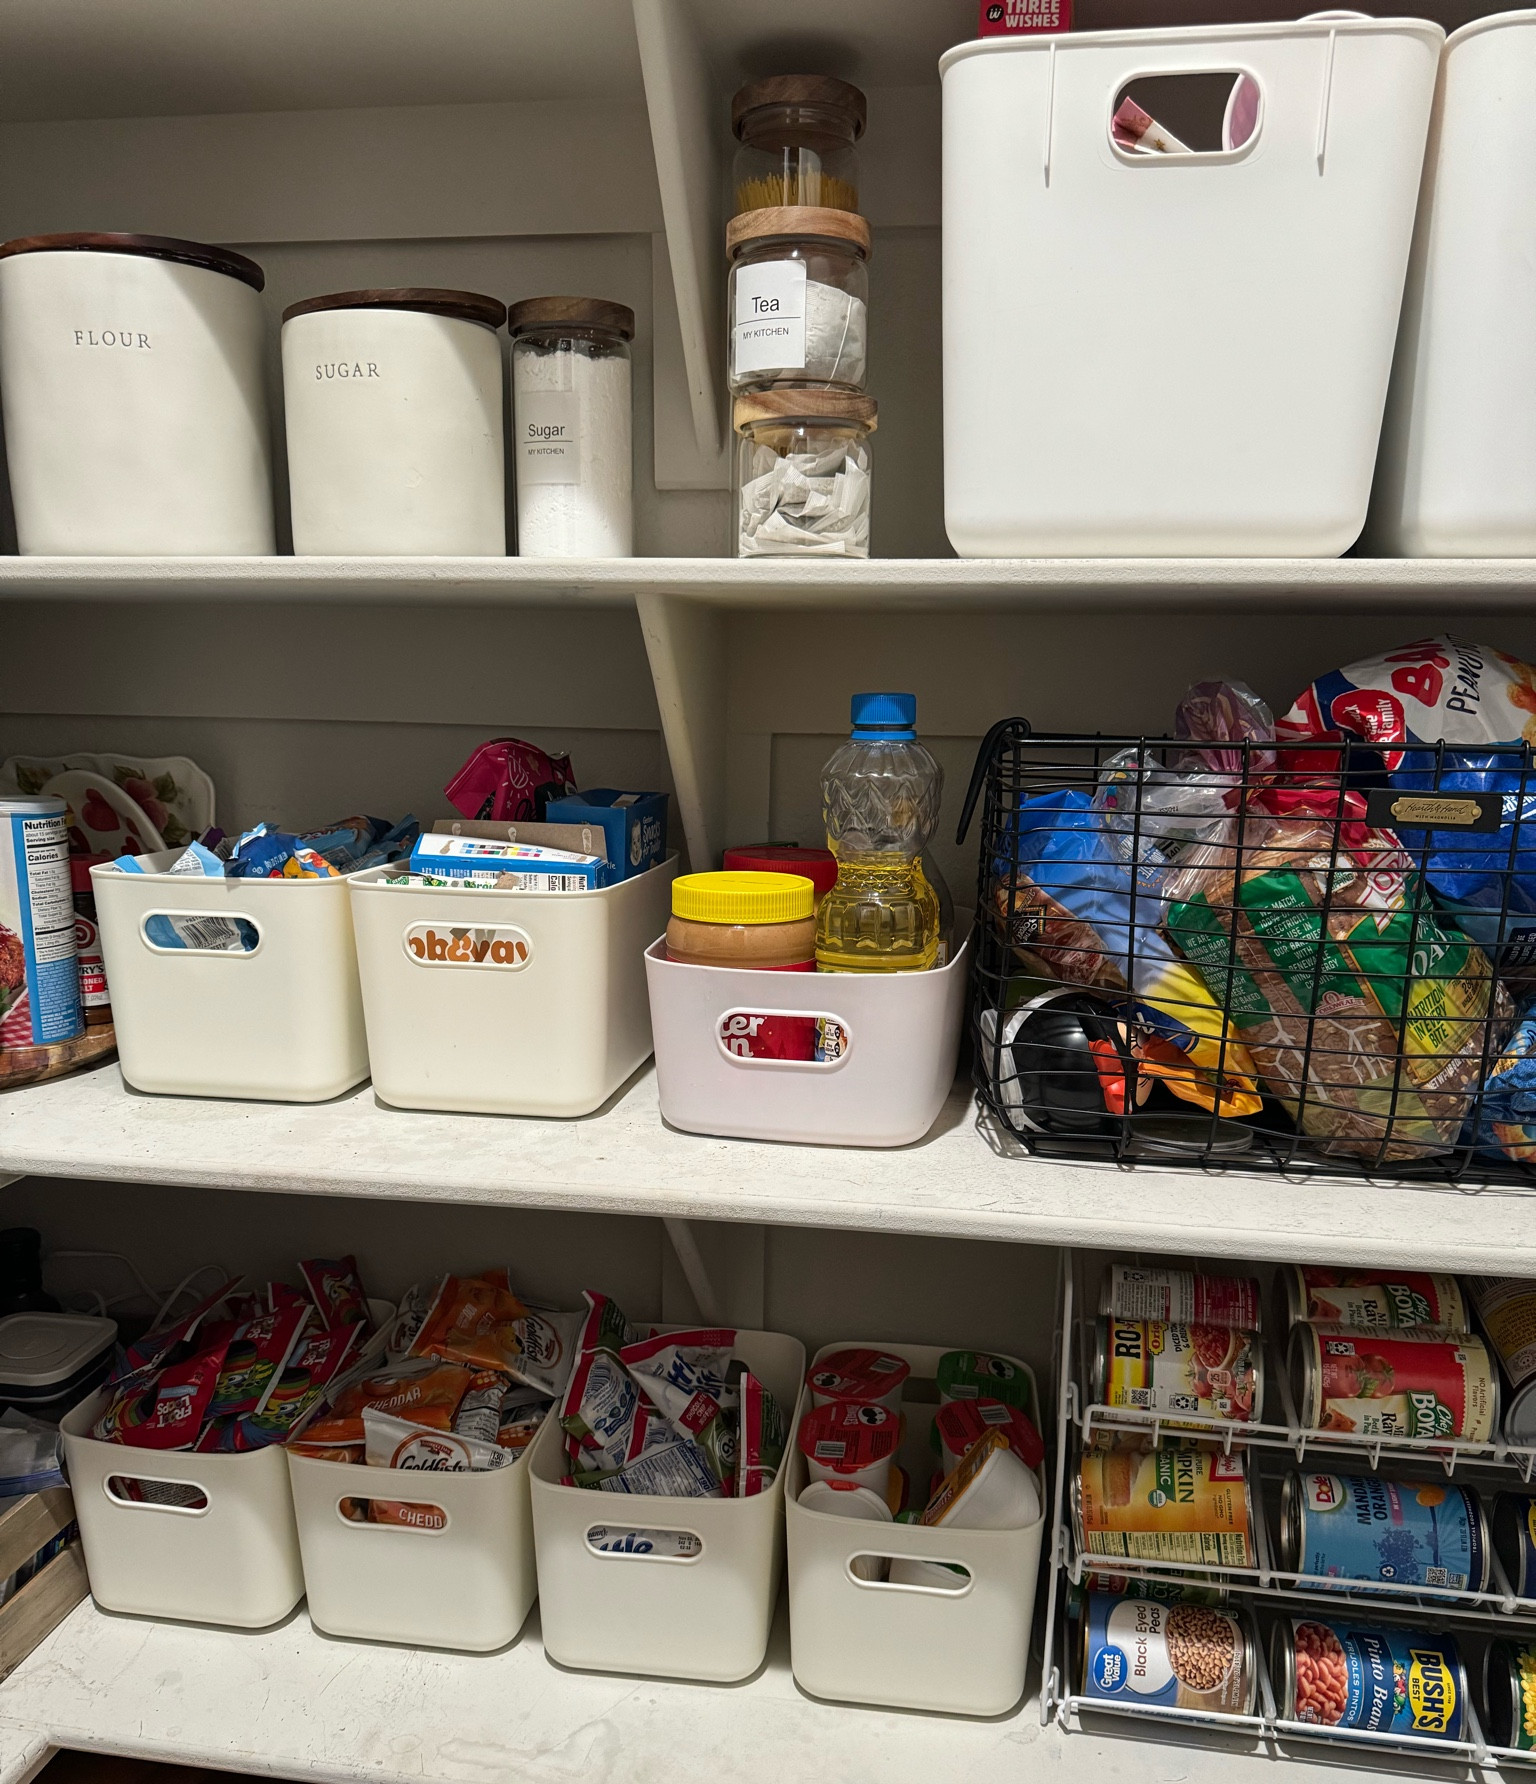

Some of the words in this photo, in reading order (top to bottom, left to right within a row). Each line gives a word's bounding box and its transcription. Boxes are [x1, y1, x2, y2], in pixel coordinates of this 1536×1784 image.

[1006, 0, 1059, 13] THREE
[1005, 14, 1059, 28] WISHES
[751, 296, 780, 313] Tea
[74, 330, 151, 349] FLOUR
[743, 331, 752, 340] MY
[754, 328, 789, 338] KITCHEN
[315, 362, 380, 380] SUGAR
[528, 423, 566, 440] Sugar
[1376, 699, 1395, 734] family
[24, 819, 60, 830] Nutrition
[28, 852, 59, 862] Calories
[1272, 894, 1297, 909] MATCH
[1266, 912, 1310, 936] ELECTRICITY
[1303, 922, 1312, 932] IN
[1185, 937, 1198, 948] WE
[1198, 934, 1212, 944] ARE
[1207, 938, 1226, 952] HARD
[1273, 946, 1288, 957] OUR
[1294, 946, 1313, 960] WITH
[1241, 993, 1260, 1007] BAKED
[1406, 985, 1446, 1029] NUTRITION
[1413, 1024, 1424, 1041] IN
[1428, 1023, 1449, 1049] BITE
[1363, 1298, 1378, 1327] Rav
[1387, 1284, 1416, 1328] BOYA
[1411, 1291, 1431, 1321] Chef
[525, 1314, 543, 1365] Goldfish
[1172, 1333, 1183, 1352] DICED
[1211, 1373, 1220, 1382] 25
[1479, 1377, 1486, 1389] NO
[156, 1395, 190, 1413] LOOPS
[366, 1387, 422, 1409] CHEDDAR
[686, 1392, 708, 1421] CHOCOLATE
[1472, 1385, 1480, 1408] Flavors
[156, 1404, 193, 1428] FROOT
[697, 1403, 707, 1417] CHIP
[1363, 1414, 1370, 1422] in
[1409, 1392, 1437, 1438] BOYA
[1436, 1403, 1454, 1434] Chef
[1372, 1417, 1380, 1430] Beef
[1380, 1411, 1397, 1438] Rav
[1160, 1450, 1171, 1486] GANIC
[1196, 1459, 1204, 1476] PURE
[698, 1475, 710, 1490] 190
[1313, 1475, 1332, 1503] Dole
[1218, 1494, 1224, 1503] NO
[1351, 1475, 1372, 1526] MANDAR
[399, 1508, 444, 1528] CHEDD
[1465, 1501, 1475, 1526] GOODNESS
[1203, 1533, 1211, 1551] Calories
[1235, 1534, 1243, 1556] Nutrition
[1470, 1527, 1478, 1553] TROPICAL
[1135, 1605, 1148, 1633] Eyed
[1149, 1607, 1161, 1634] Peas
[1134, 1637, 1147, 1677] Black
[1344, 1640, 1361, 1686] FRIJOLES
[1363, 1637, 1386, 1681] Pinto
[1100, 1653, 1114, 1688] Great
[1111, 1655, 1121, 1682] Value
[1411, 1677, 1421, 1702] BEST
[1414, 1652, 1444, 1728] BUSH'S
[1346, 1688, 1360, 1721] PINTOS
[1365, 1684, 1388, 1731] Beans
